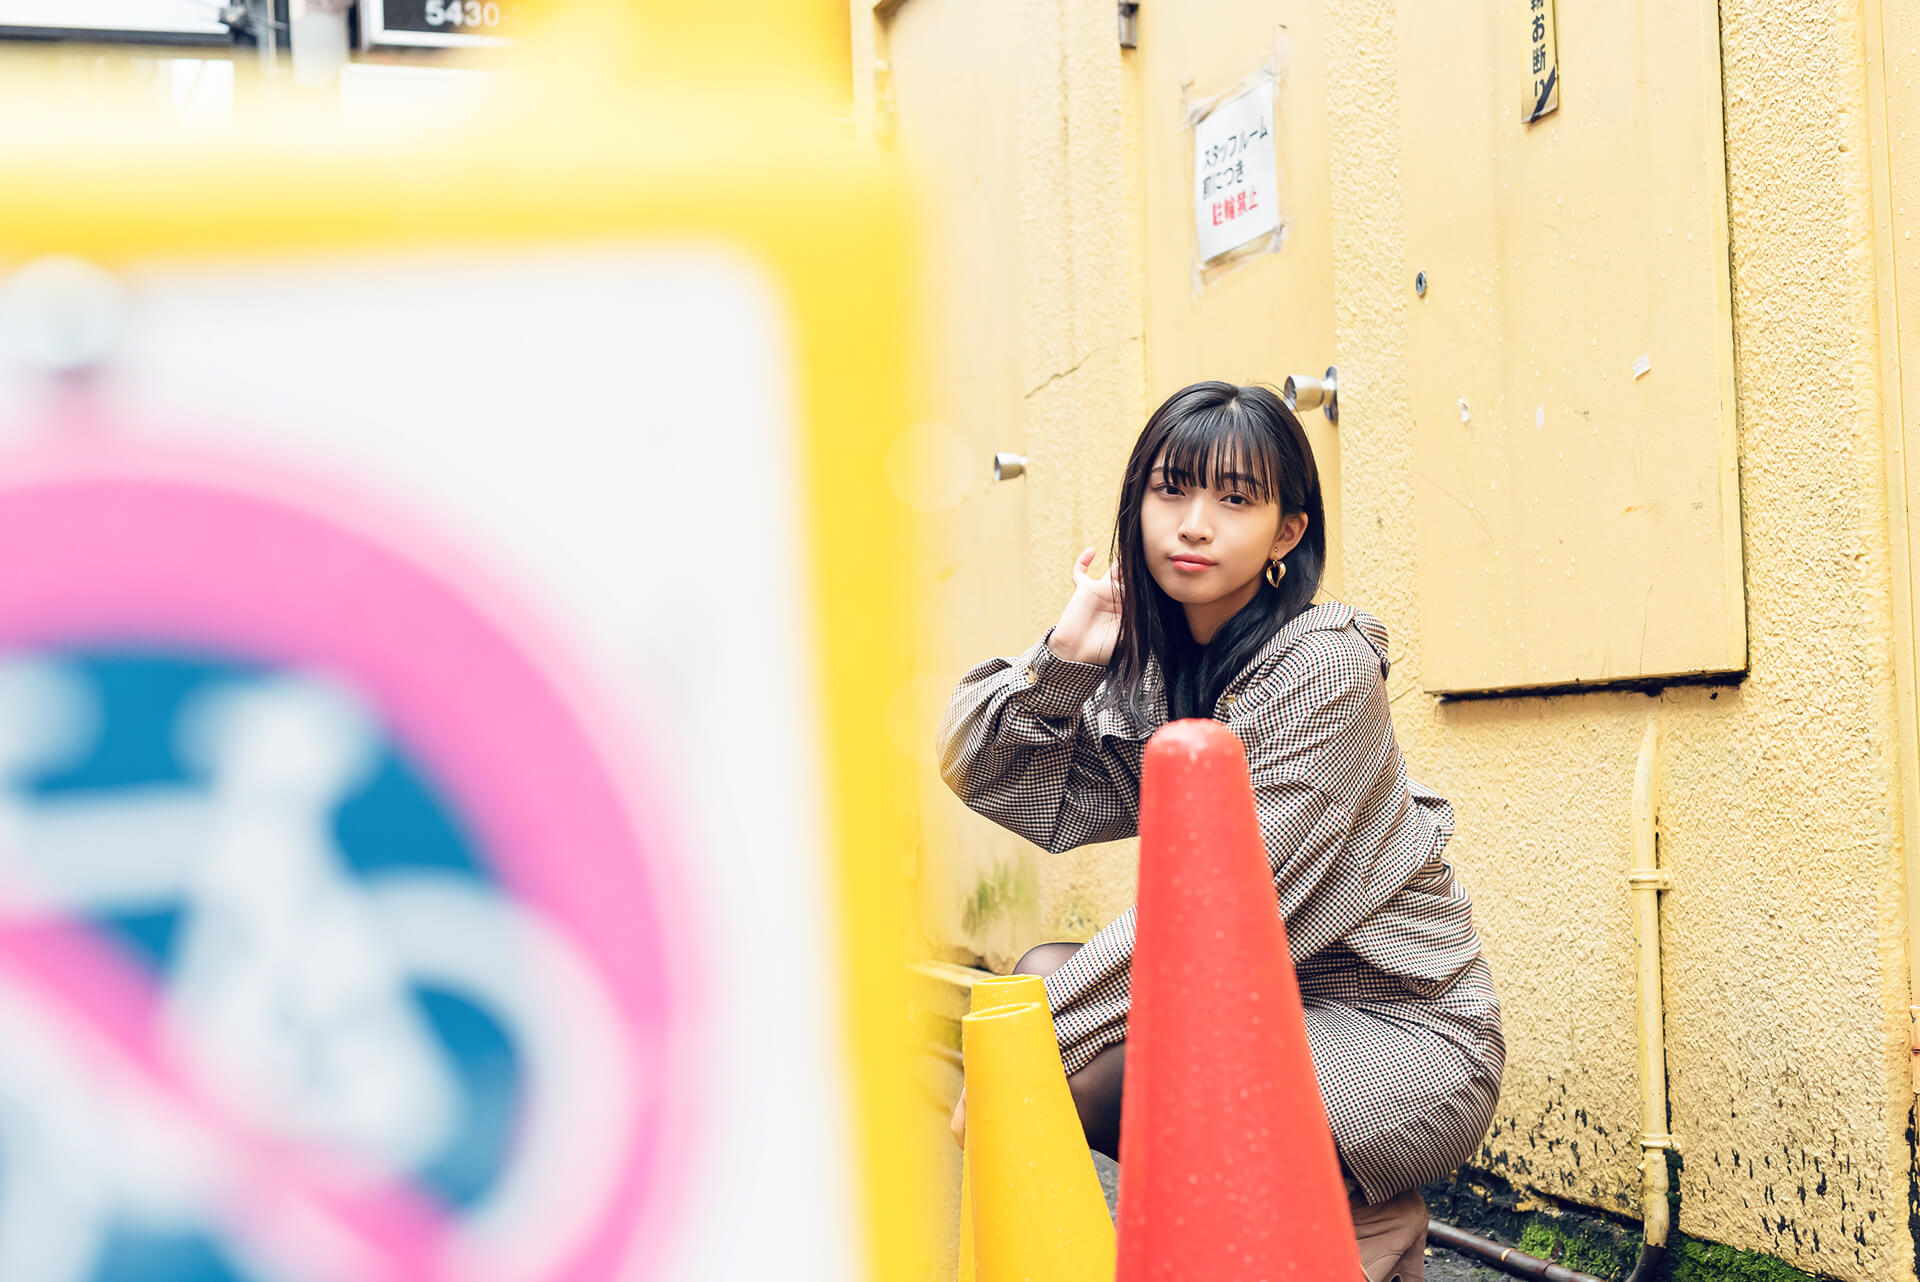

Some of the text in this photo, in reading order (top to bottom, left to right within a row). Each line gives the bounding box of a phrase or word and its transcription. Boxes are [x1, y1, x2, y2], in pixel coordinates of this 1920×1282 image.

[1202, 114, 1269, 170] スタッフルーム
[1211, 184, 1259, 227] 駐輪禁止
